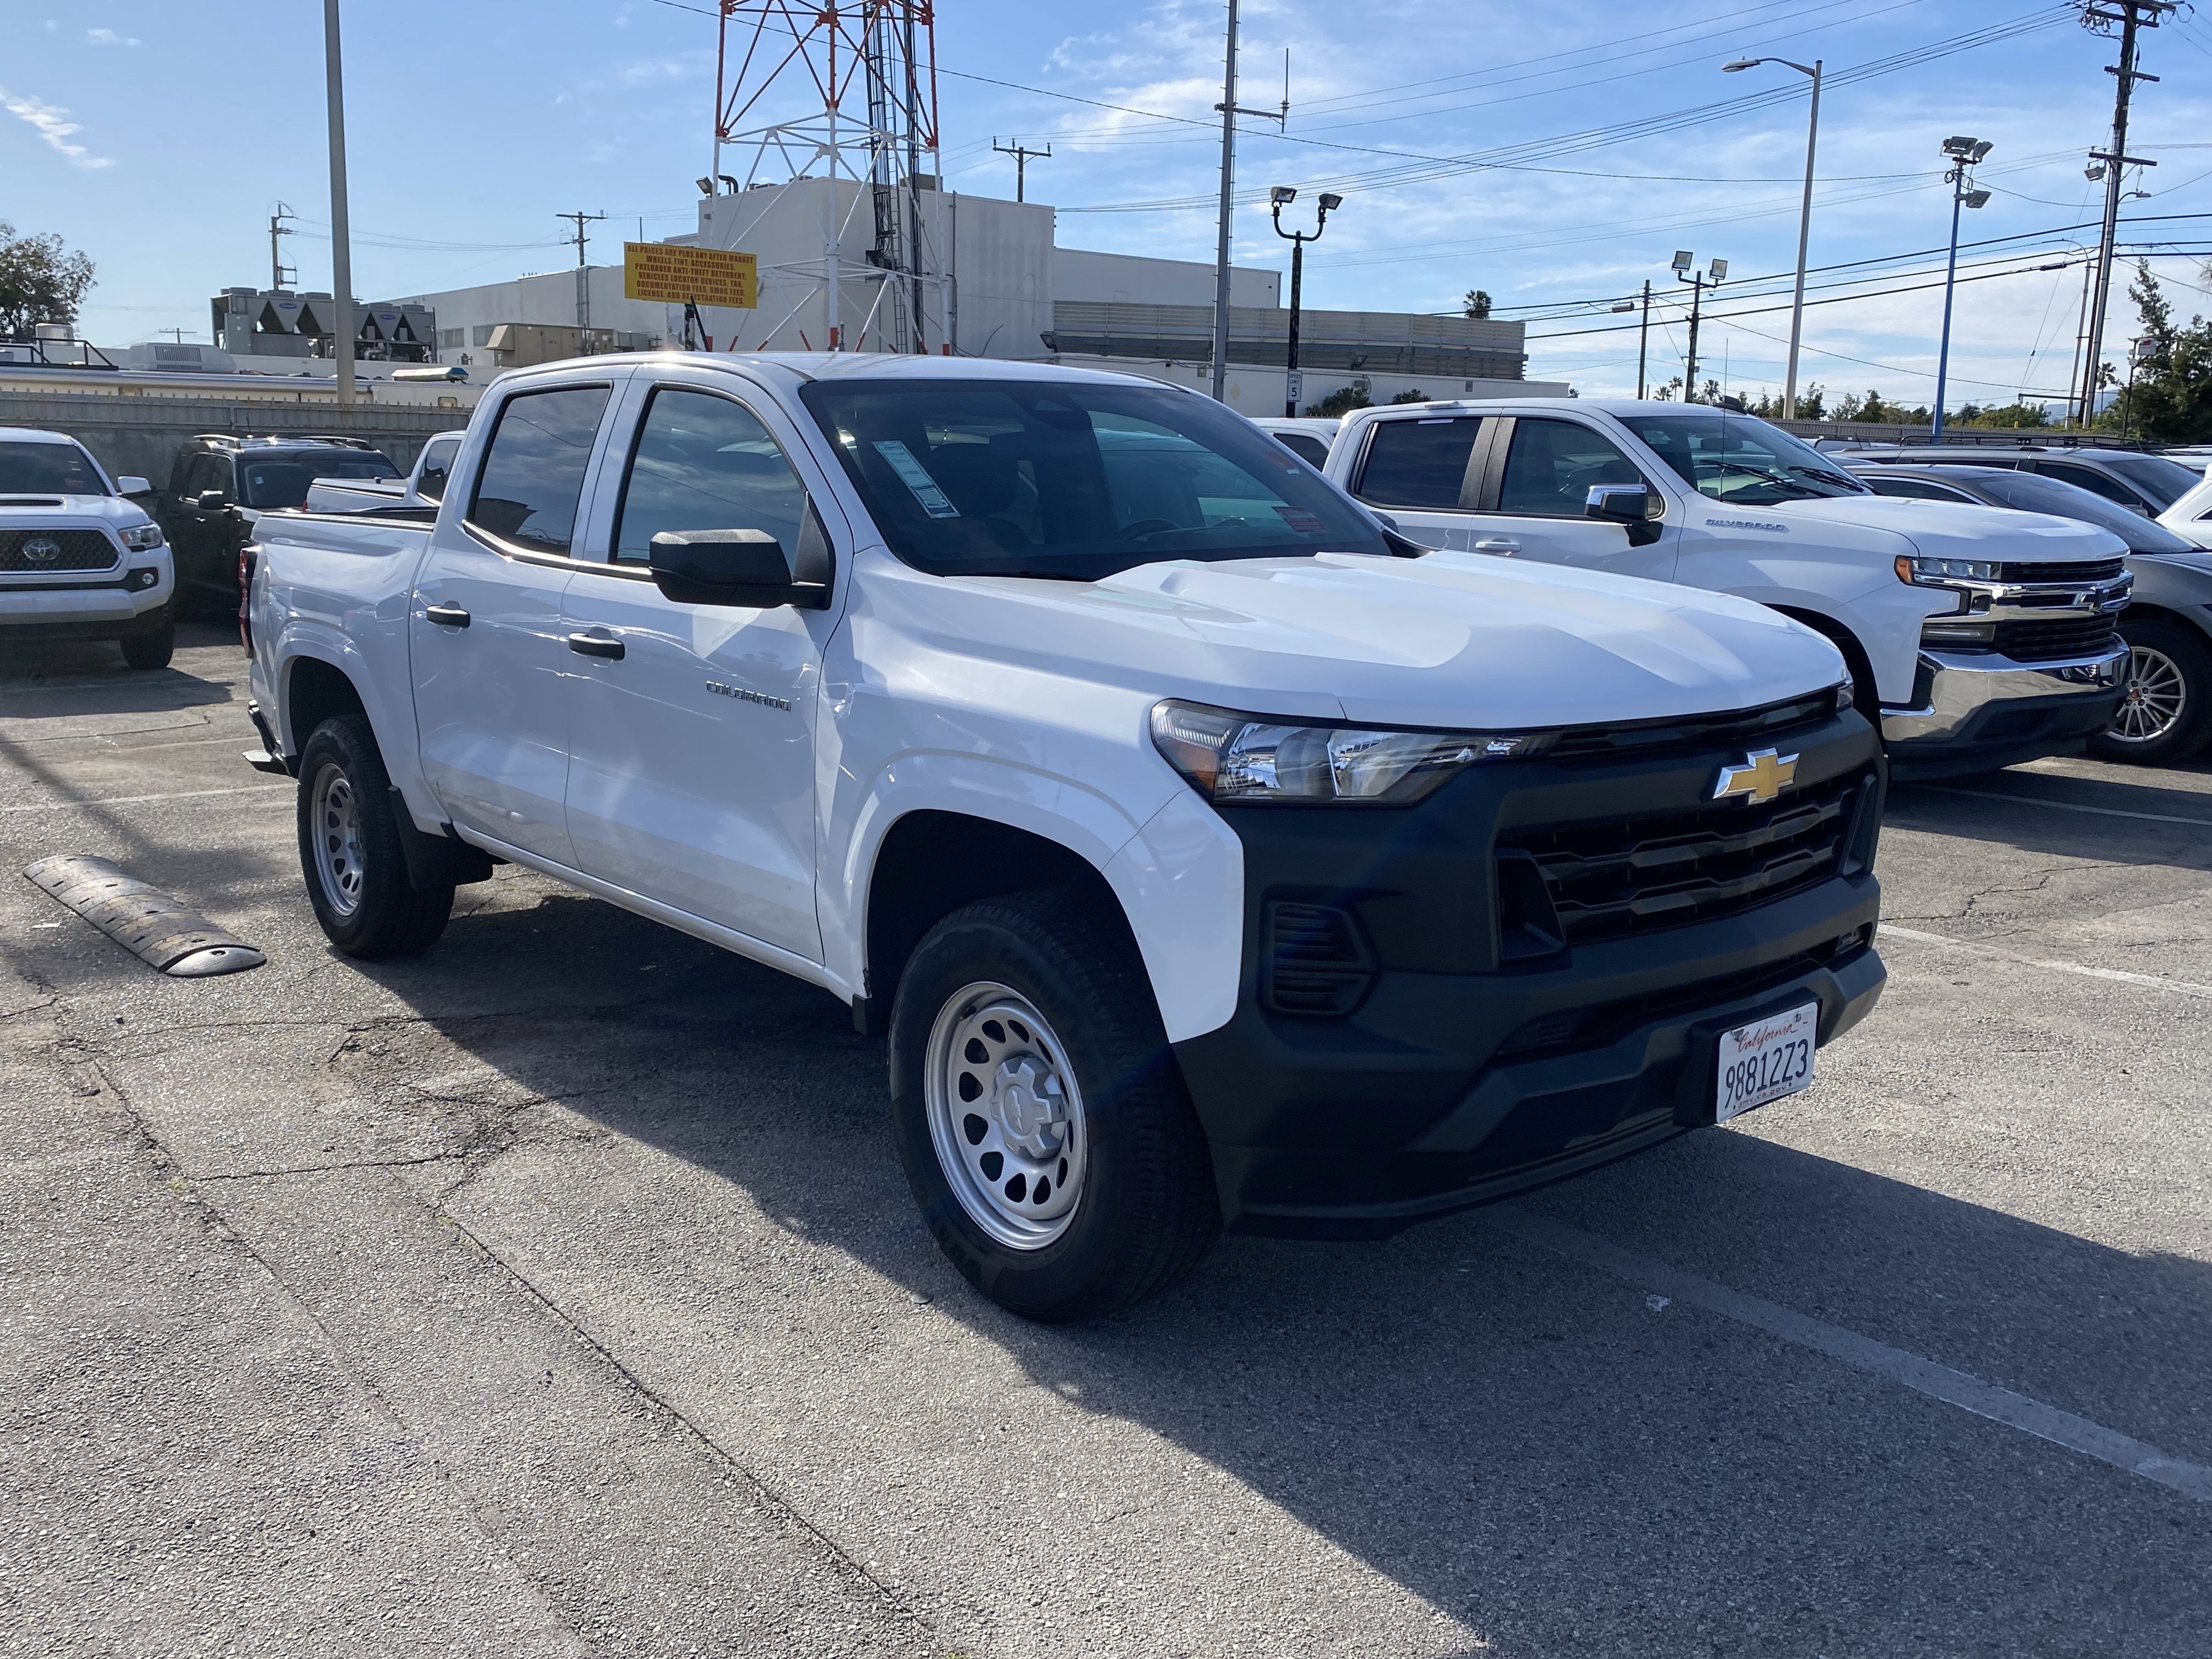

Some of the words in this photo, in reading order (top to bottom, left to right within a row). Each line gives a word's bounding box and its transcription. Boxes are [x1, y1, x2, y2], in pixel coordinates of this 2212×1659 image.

[640, 246, 663, 255] PRICES
[729, 255, 753, 263] MARKET
[635, 263, 671, 273] PRELOADED
[674, 267, 709, 276] ANTI-THEFT
[639, 272, 668, 281] VEHICLES
[671, 275, 698, 283] LOCATOR
[637, 280, 690, 291] DOCUMENTATION
[682, 293, 727, 303] REISTRATION
[1291, 387, 1297, 397] 5
[1705, 519, 1785, 531] SILVERADO
[706, 680, 791, 712] COLORADO
[1738, 1024, 1798, 1053] California
[1724, 1039, 1809, 1109] 98812Z3
[1738, 1085, 1787, 1109] dmv.ca.gov
